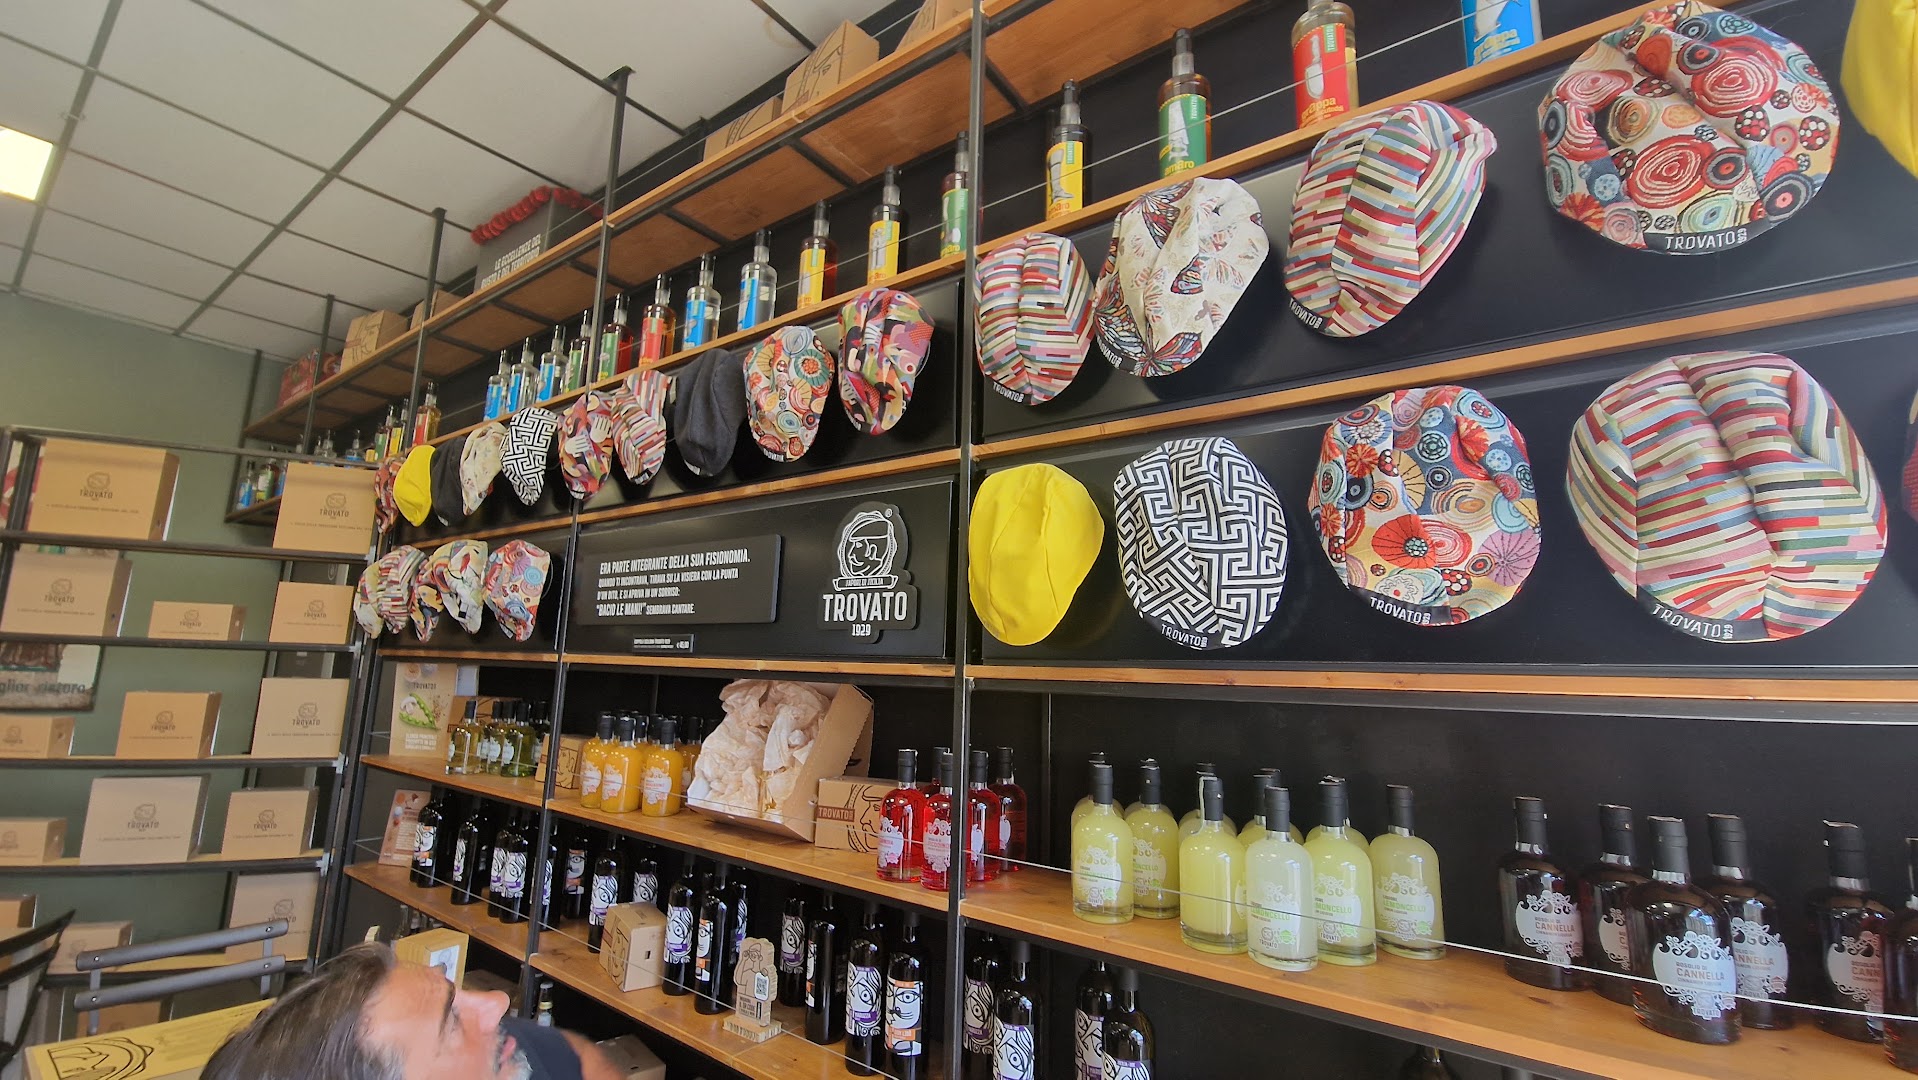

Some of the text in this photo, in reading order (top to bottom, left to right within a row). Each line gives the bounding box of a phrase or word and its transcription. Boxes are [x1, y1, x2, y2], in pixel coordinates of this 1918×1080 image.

[1665, 231, 1735, 250] TROVATO
[1289, 297, 1317, 326] TROVATO
[79, 488, 113, 499] TROVATO
[320, 508, 350, 518] TROVATO
[600, 548, 750, 575] ERA PARTE INTEGRANTE DELLA SUA FISIONOMIA.
[598, 577, 615, 588] QUANDO
[666, 573, 673, 583] SU
[674, 572, 680, 582] LA
[681, 570, 700, 582] VISIERA
[701, 569, 712, 581] CON
[712, 569, 720, 580] LA
[720, 568, 739, 579] PUNTA
[616, 602, 624, 616] LE
[646, 603, 671, 615] SEMBRAVA
[671, 603, 695, 615] CANTARE.
[822, 592, 908, 622] TROVATO
[1370, 597, 1422, 624] TROVATO
[1652, 603, 1721, 638] TROVATO
[852, 624, 871, 636] 1929
[1161, 623, 1202, 647] TROVATO
[818, 807, 849, 820] TROVATO
[1535, 921, 1575, 932] CANNELLA
[1676, 961, 1700, 970] ROSOLIO
[1676, 968, 1725, 980] CANNELLA
[1694, 1009, 1719, 1017] TROVATO
